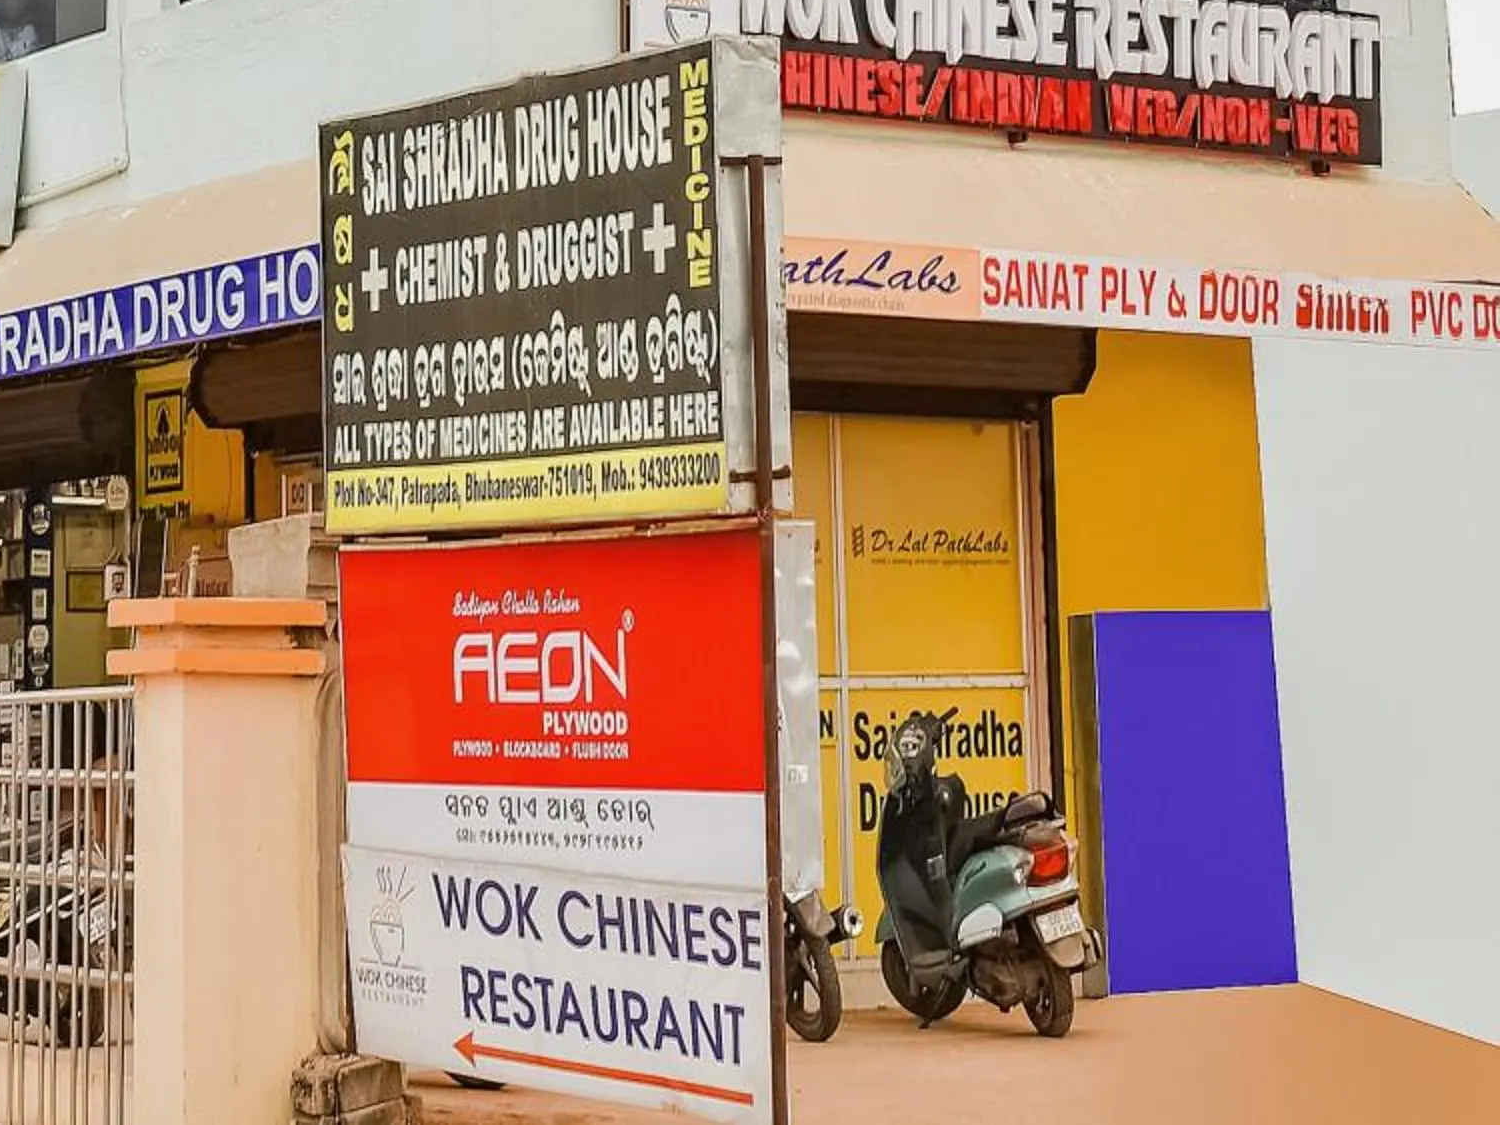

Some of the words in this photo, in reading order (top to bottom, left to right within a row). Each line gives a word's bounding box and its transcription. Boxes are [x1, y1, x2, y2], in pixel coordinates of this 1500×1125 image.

[784, 49, 1093, 134] HINESE/INDIAN
[361, 132, 397, 216] SAI
[401, 108, 509, 210] SHRADHA
[515, 94, 579, 191] DRUG
[587, 75, 673, 177] HOUSE
[679, 58, 711, 289] MEDICINE
[395, 236, 487, 307] CHEMIST
[495, 232, 511, 292] &
[517, 212, 635, 290] DRUGGIST
[982, 257, 1089, 313] SANAT
[1100, 266, 1157, 318] PLY
[1167, 275, 1188, 321] &
[1199, 268, 1280, 327] DOOR
[1411, 289, 1463, 338] PVC
[133, 265, 246, 349] DRUG
[333, 425, 361, 464] ALL
[364, 419, 411, 462] TYPES
[415, 417, 436, 459] OF
[439, 411, 527, 458] MEDICINES
[532, 406, 566, 451] ARE
[569, 397, 665, 448] AVAILABLE
[669, 391, 719, 437] HERE
[333, 476, 355, 509] Plot
[871, 529, 894, 554] Dr
[898, 530, 929, 554] Lal
[933, 528, 1010, 555] PathLabs
[453, 627, 628, 704] AEON
[453, 739, 492, 757] PLYWOOD
[543, 711, 628, 736] PLYWOOD
[432, 873, 543, 942] WOK
[557, 889, 763, 971] CHINESE
[459, 964, 745, 1066] RESTAURANT
